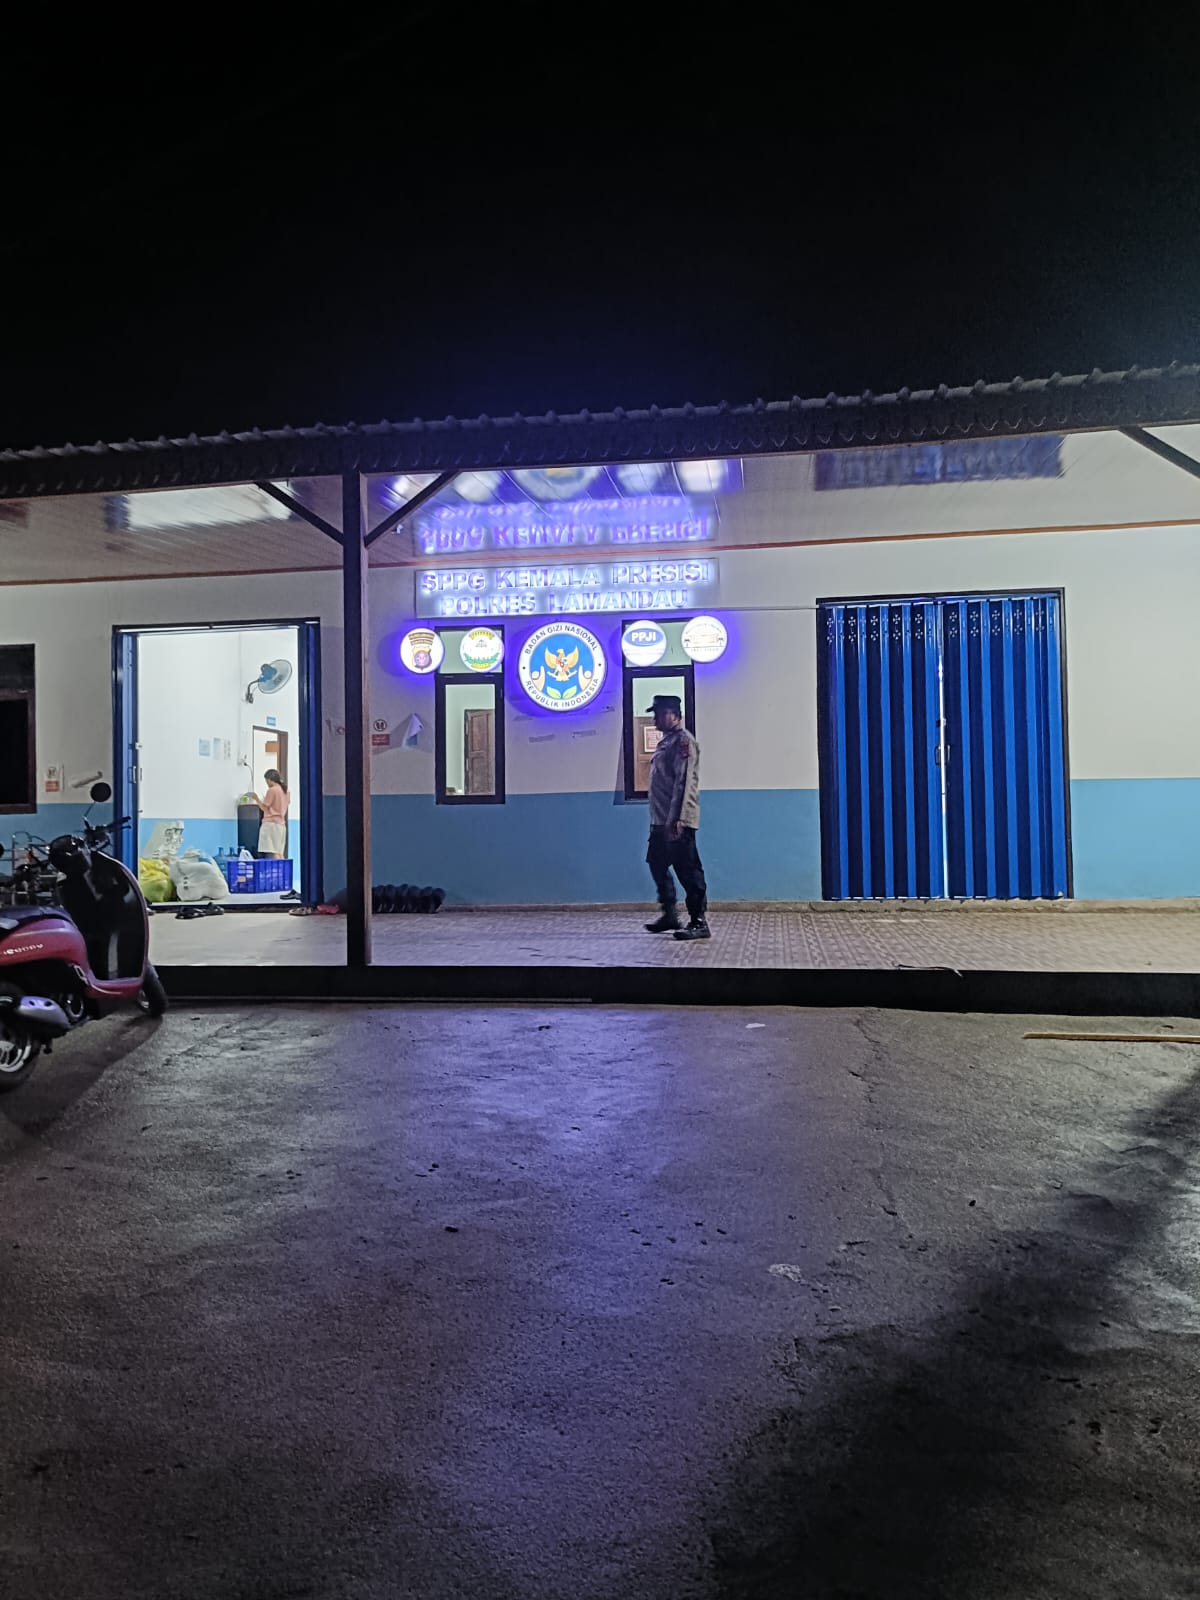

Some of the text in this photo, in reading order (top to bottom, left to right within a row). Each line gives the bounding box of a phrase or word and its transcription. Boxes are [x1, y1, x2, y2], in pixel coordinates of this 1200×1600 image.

[422, 562, 709, 592] SPPG KEMALA PRESISI
[441, 589, 688, 615] POLRES LAMANDAU
[525, 624, 598, 654] BADAN GIZI NASIONAL
[631, 631, 656, 642] PPJI
[526, 678, 598, 707] REPUBLIK INDONESIA
